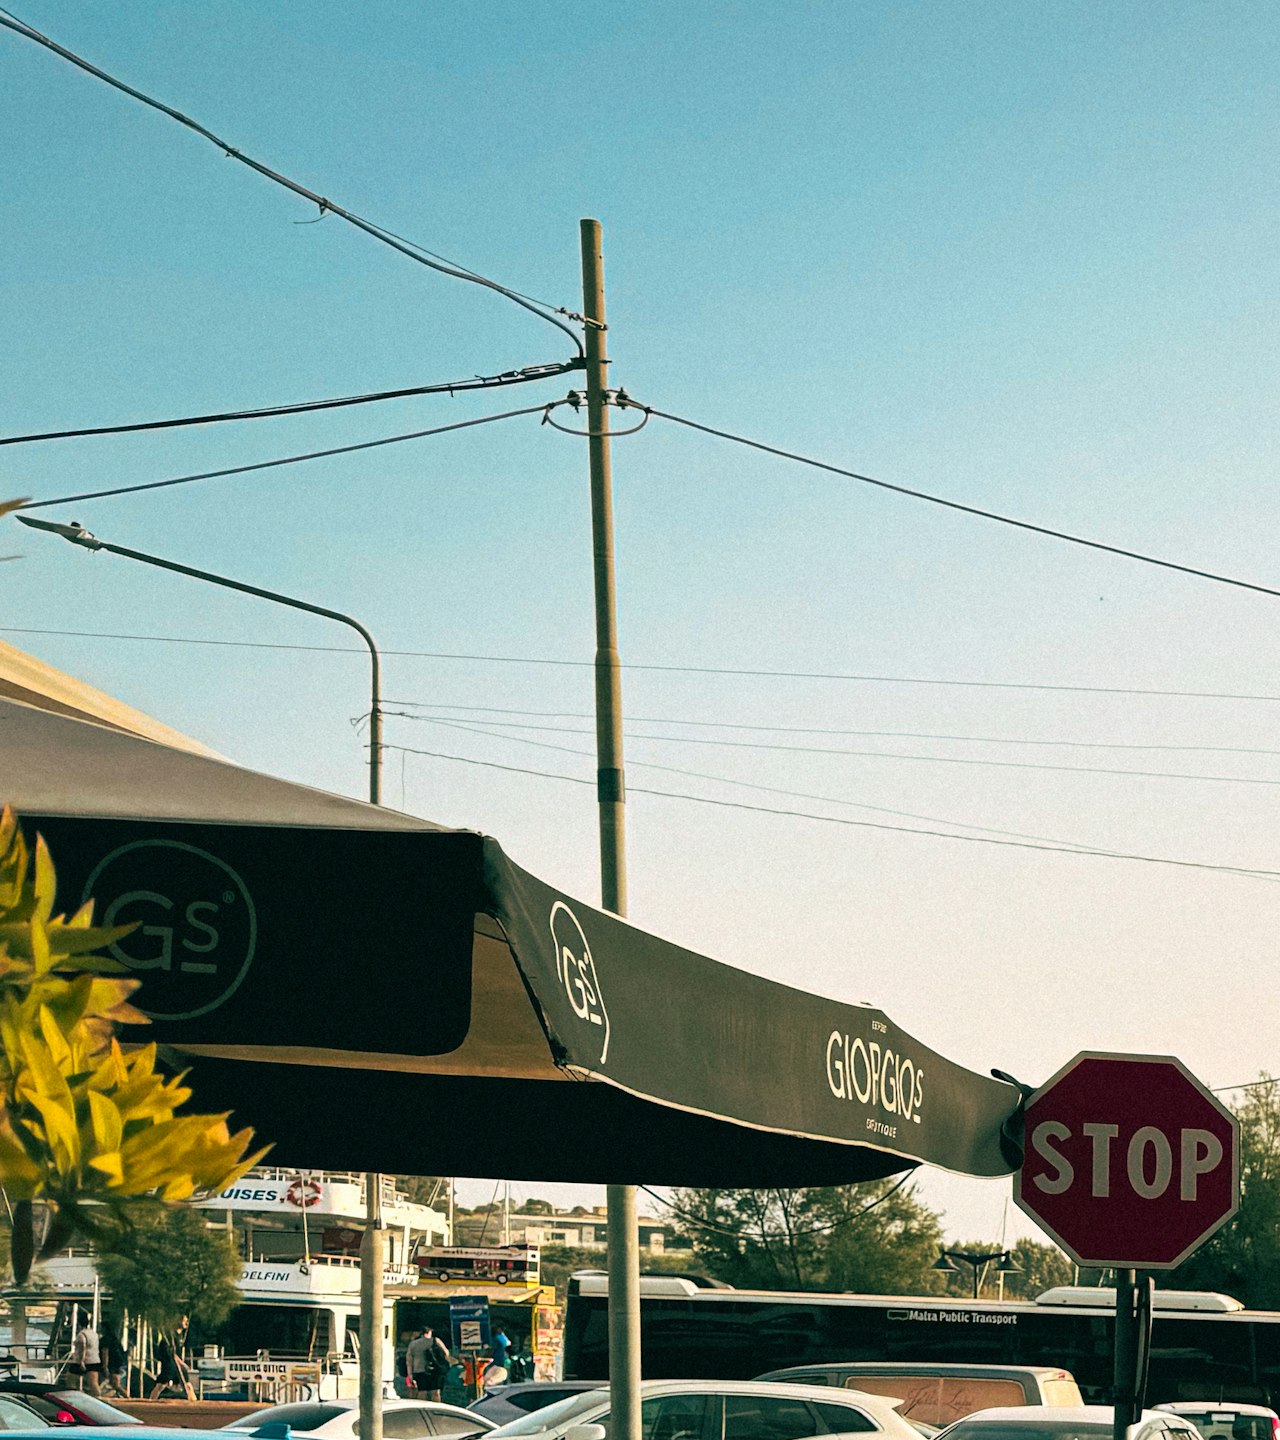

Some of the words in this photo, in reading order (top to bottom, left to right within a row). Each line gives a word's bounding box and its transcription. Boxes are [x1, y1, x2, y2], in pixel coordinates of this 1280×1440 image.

[1031, 1120, 1224, 1202] STOP
[221, 1187, 278, 1201] UISES
[909, 1310, 938, 1322] Malta
[939, 1311, 970, 1324] Public
[971, 1312, 1018, 1325] Transport
